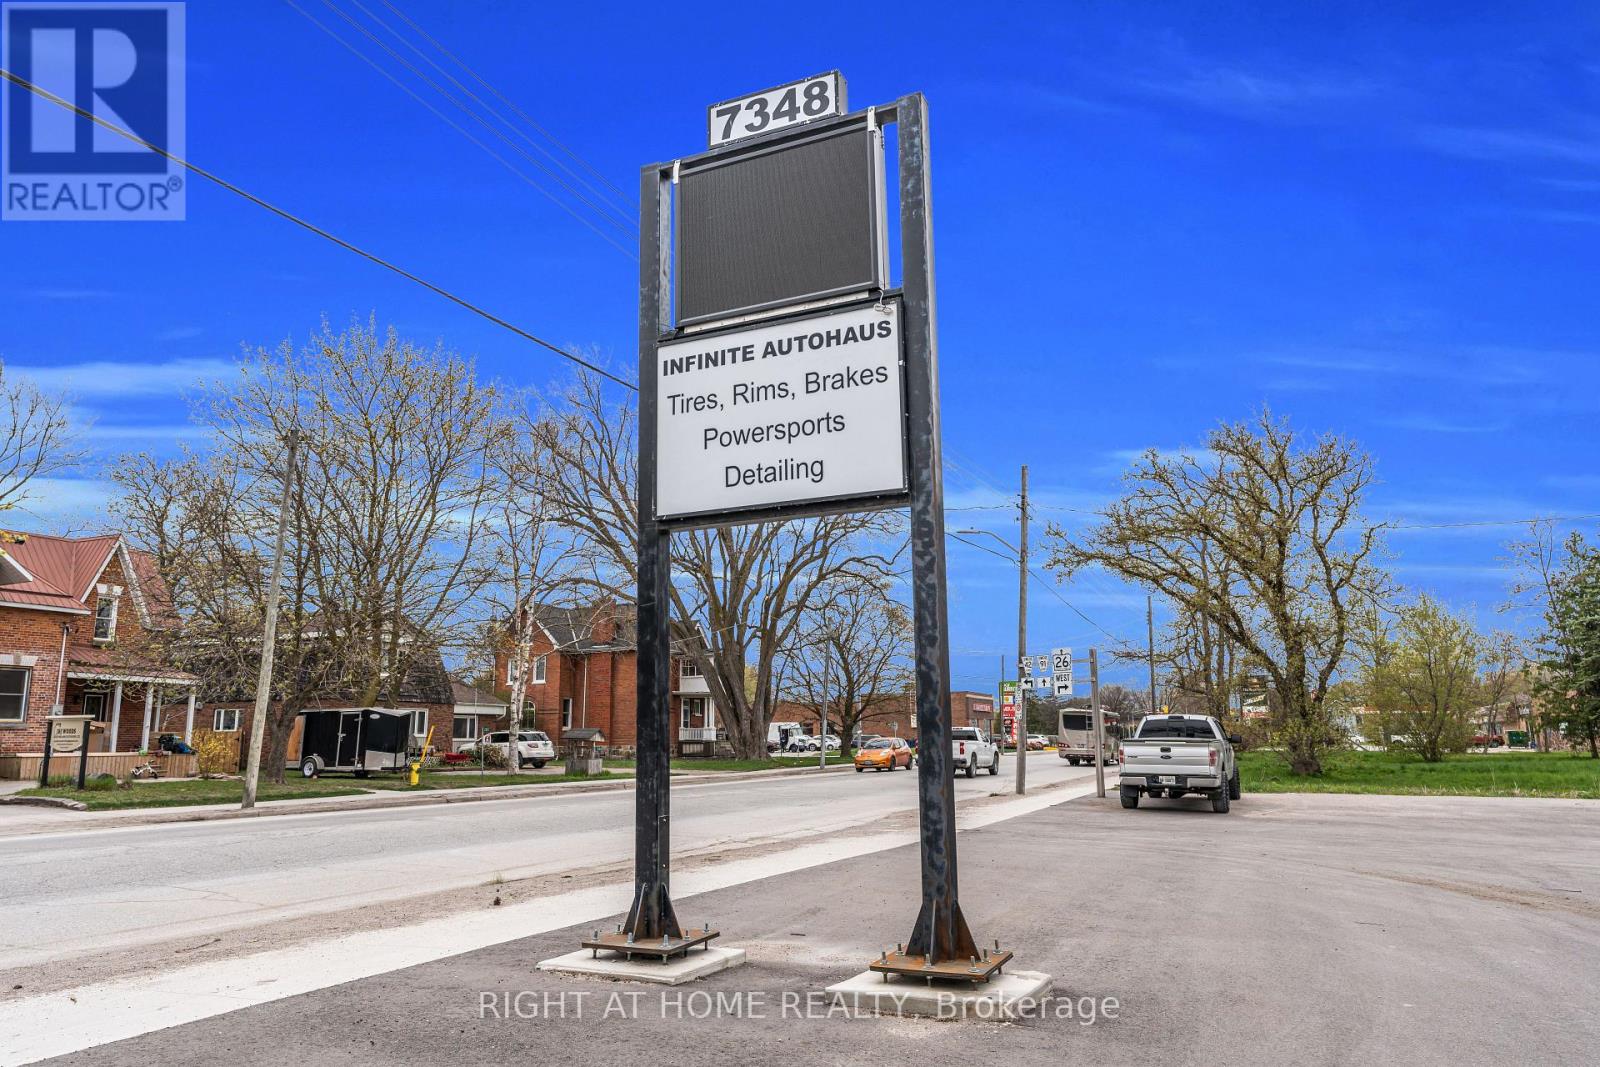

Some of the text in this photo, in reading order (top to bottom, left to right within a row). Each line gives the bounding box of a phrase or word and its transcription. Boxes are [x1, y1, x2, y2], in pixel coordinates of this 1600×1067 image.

[716, 80, 830, 141] 7348
[662, 320, 892, 376] INFINITE AUTOHAUS
[667, 365, 889, 416] Tires, Rims, Brakes
[703, 411, 846, 450] Powersports
[725, 457, 824, 488] Detailing
[1055, 656, 1069, 668] 26
[1055, 674, 1070, 682] WEST
